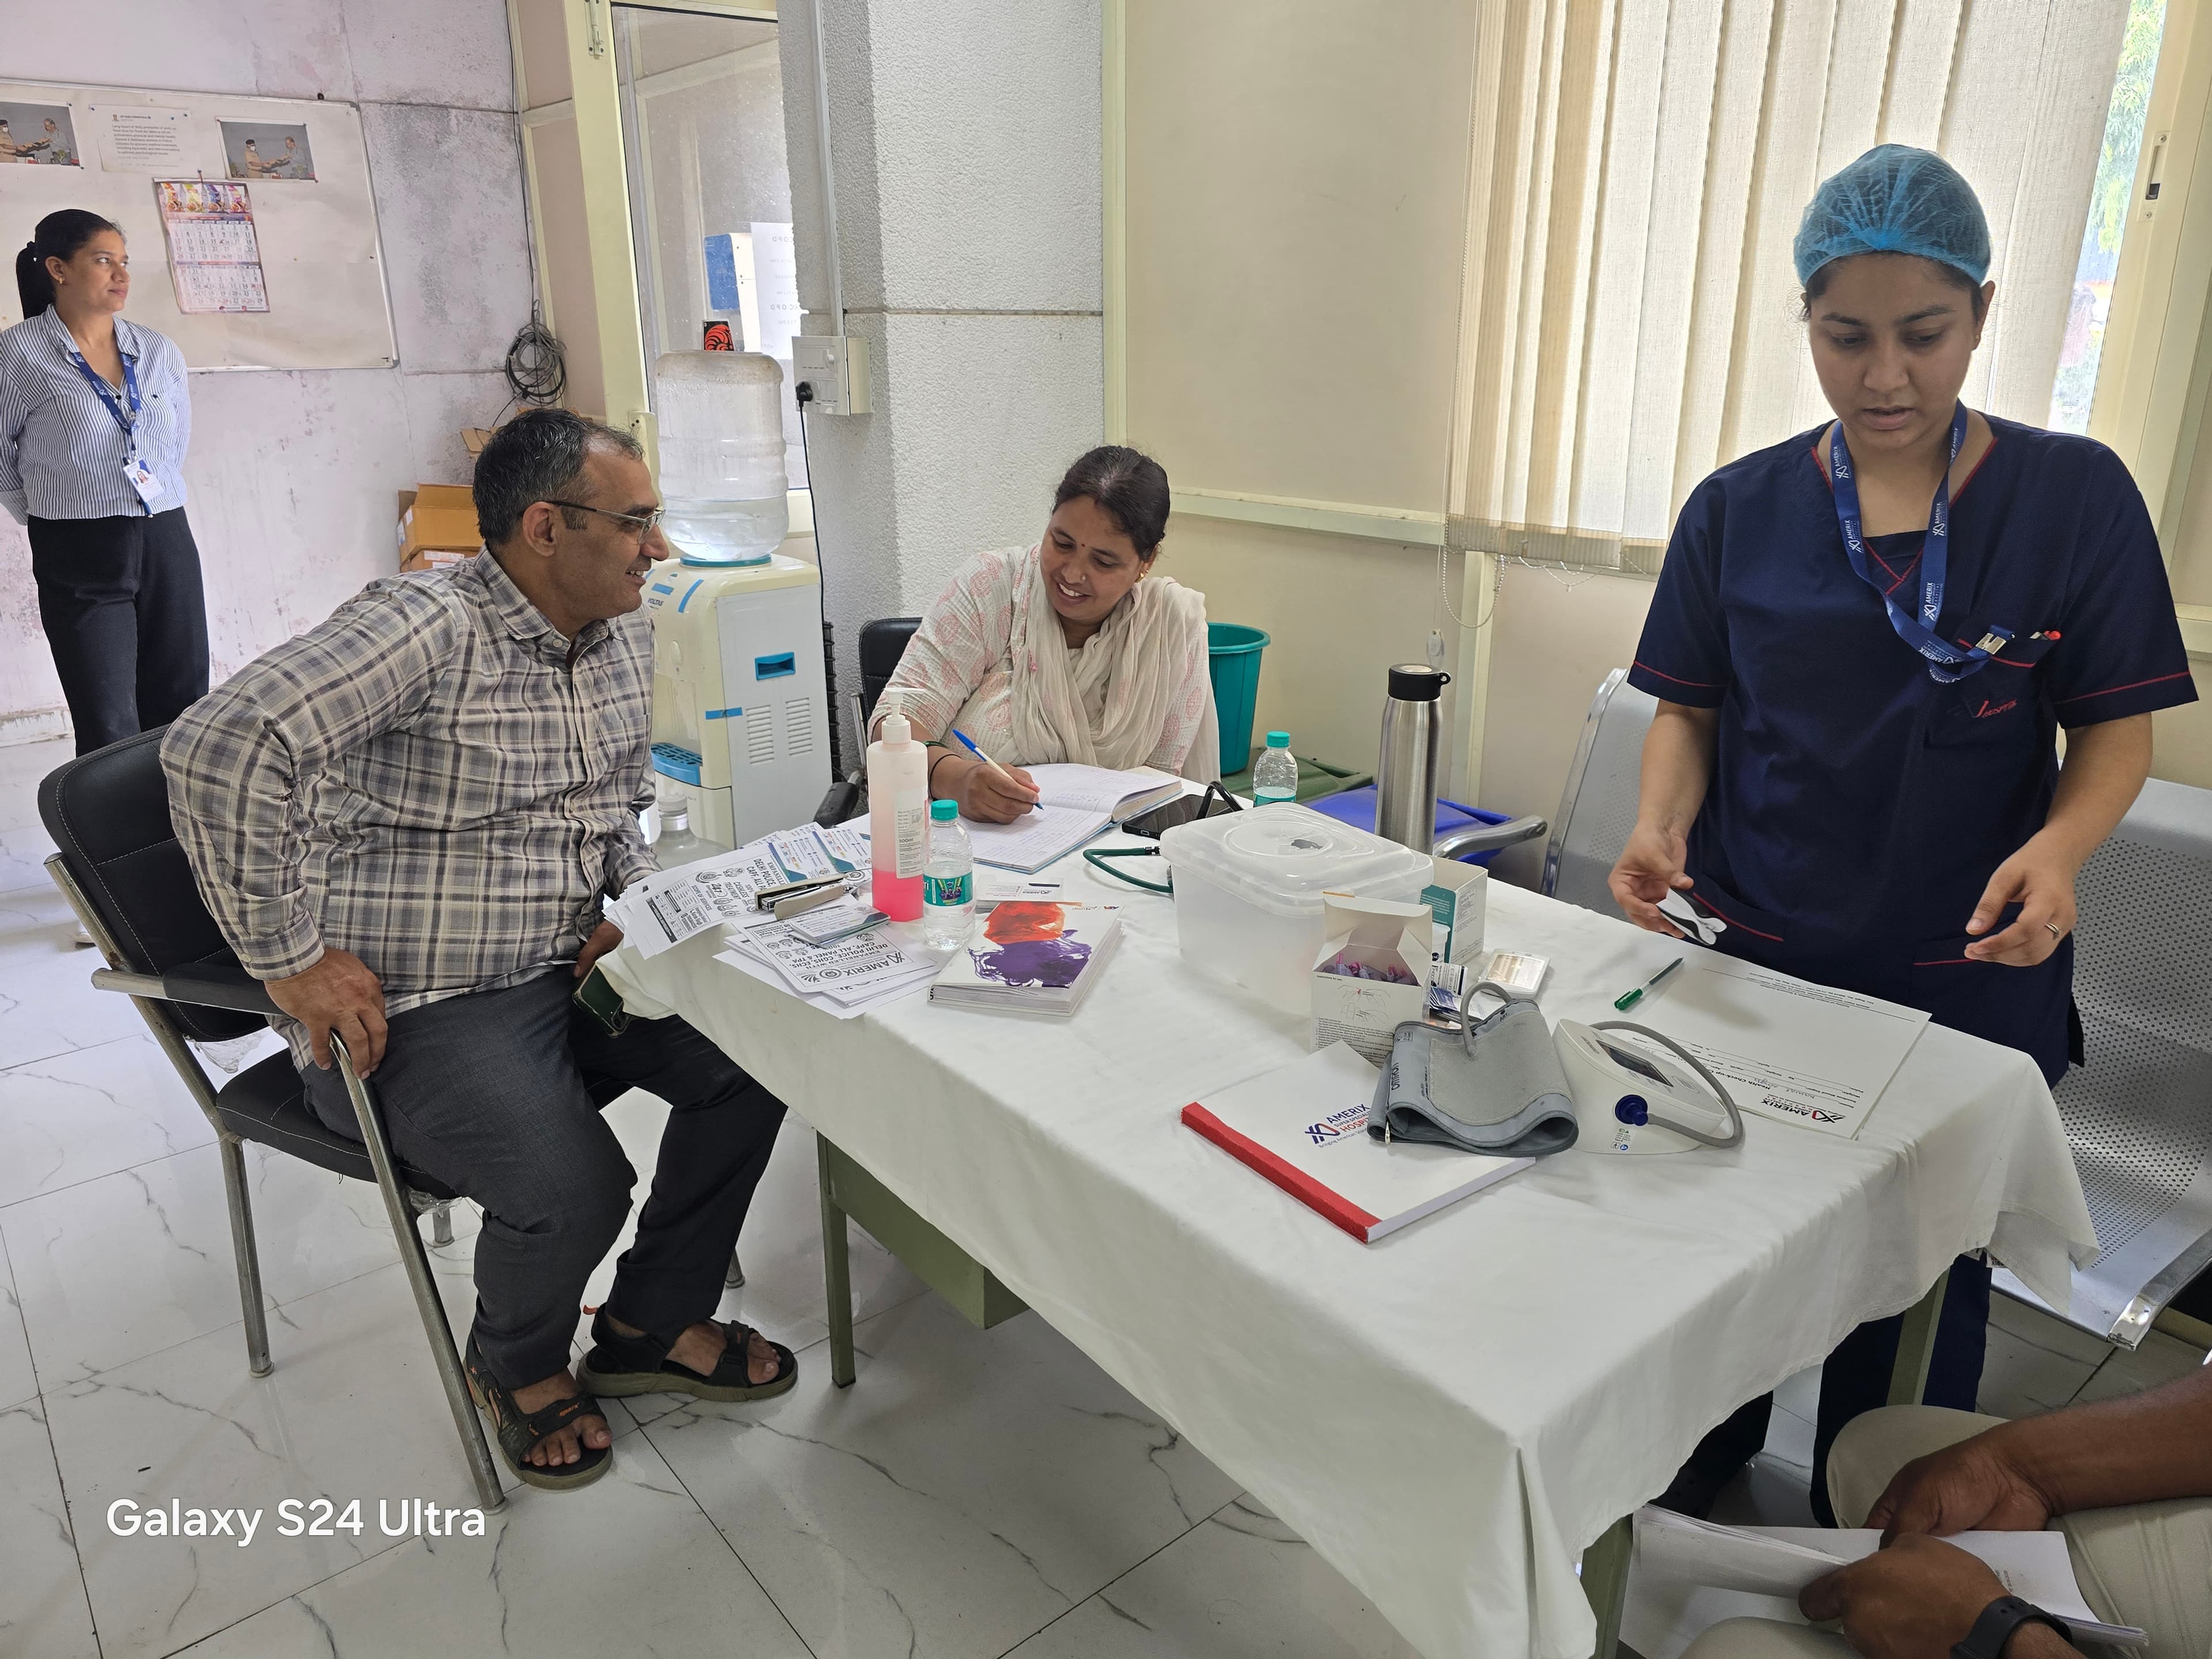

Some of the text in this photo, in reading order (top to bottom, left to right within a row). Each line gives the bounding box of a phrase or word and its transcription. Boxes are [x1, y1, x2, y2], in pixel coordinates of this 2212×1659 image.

[1844, 520, 1854, 540] AMERIX
[1925, 582, 1934, 604] AMERIX
[647, 597, 664, 606] VOLTAS
[1918, 647, 1944, 663] AMERIX
[747, 866, 759, 879] CAPF,
[753, 858, 767, 871] DELHI
[761, 870, 776, 887] POLICE,
[691, 885, 702, 894] SCOPE
[813, 950, 838, 958] PANEL
[865, 944, 888, 952] DELHI
[828, 950, 880, 964] EMPANELLED
[843, 960, 889, 976] AMERIX
[1499, 1012, 1510, 1022] ART.
[1391, 1062, 1400, 1090] OMRON
[1715, 1071, 1770, 1090] Health Check-up
[1326, 1104, 1370, 1124] AMERIX
[1761, 1099, 1809, 1116] AMERIX
[1334, 1118, 1351, 1128] SUPER
